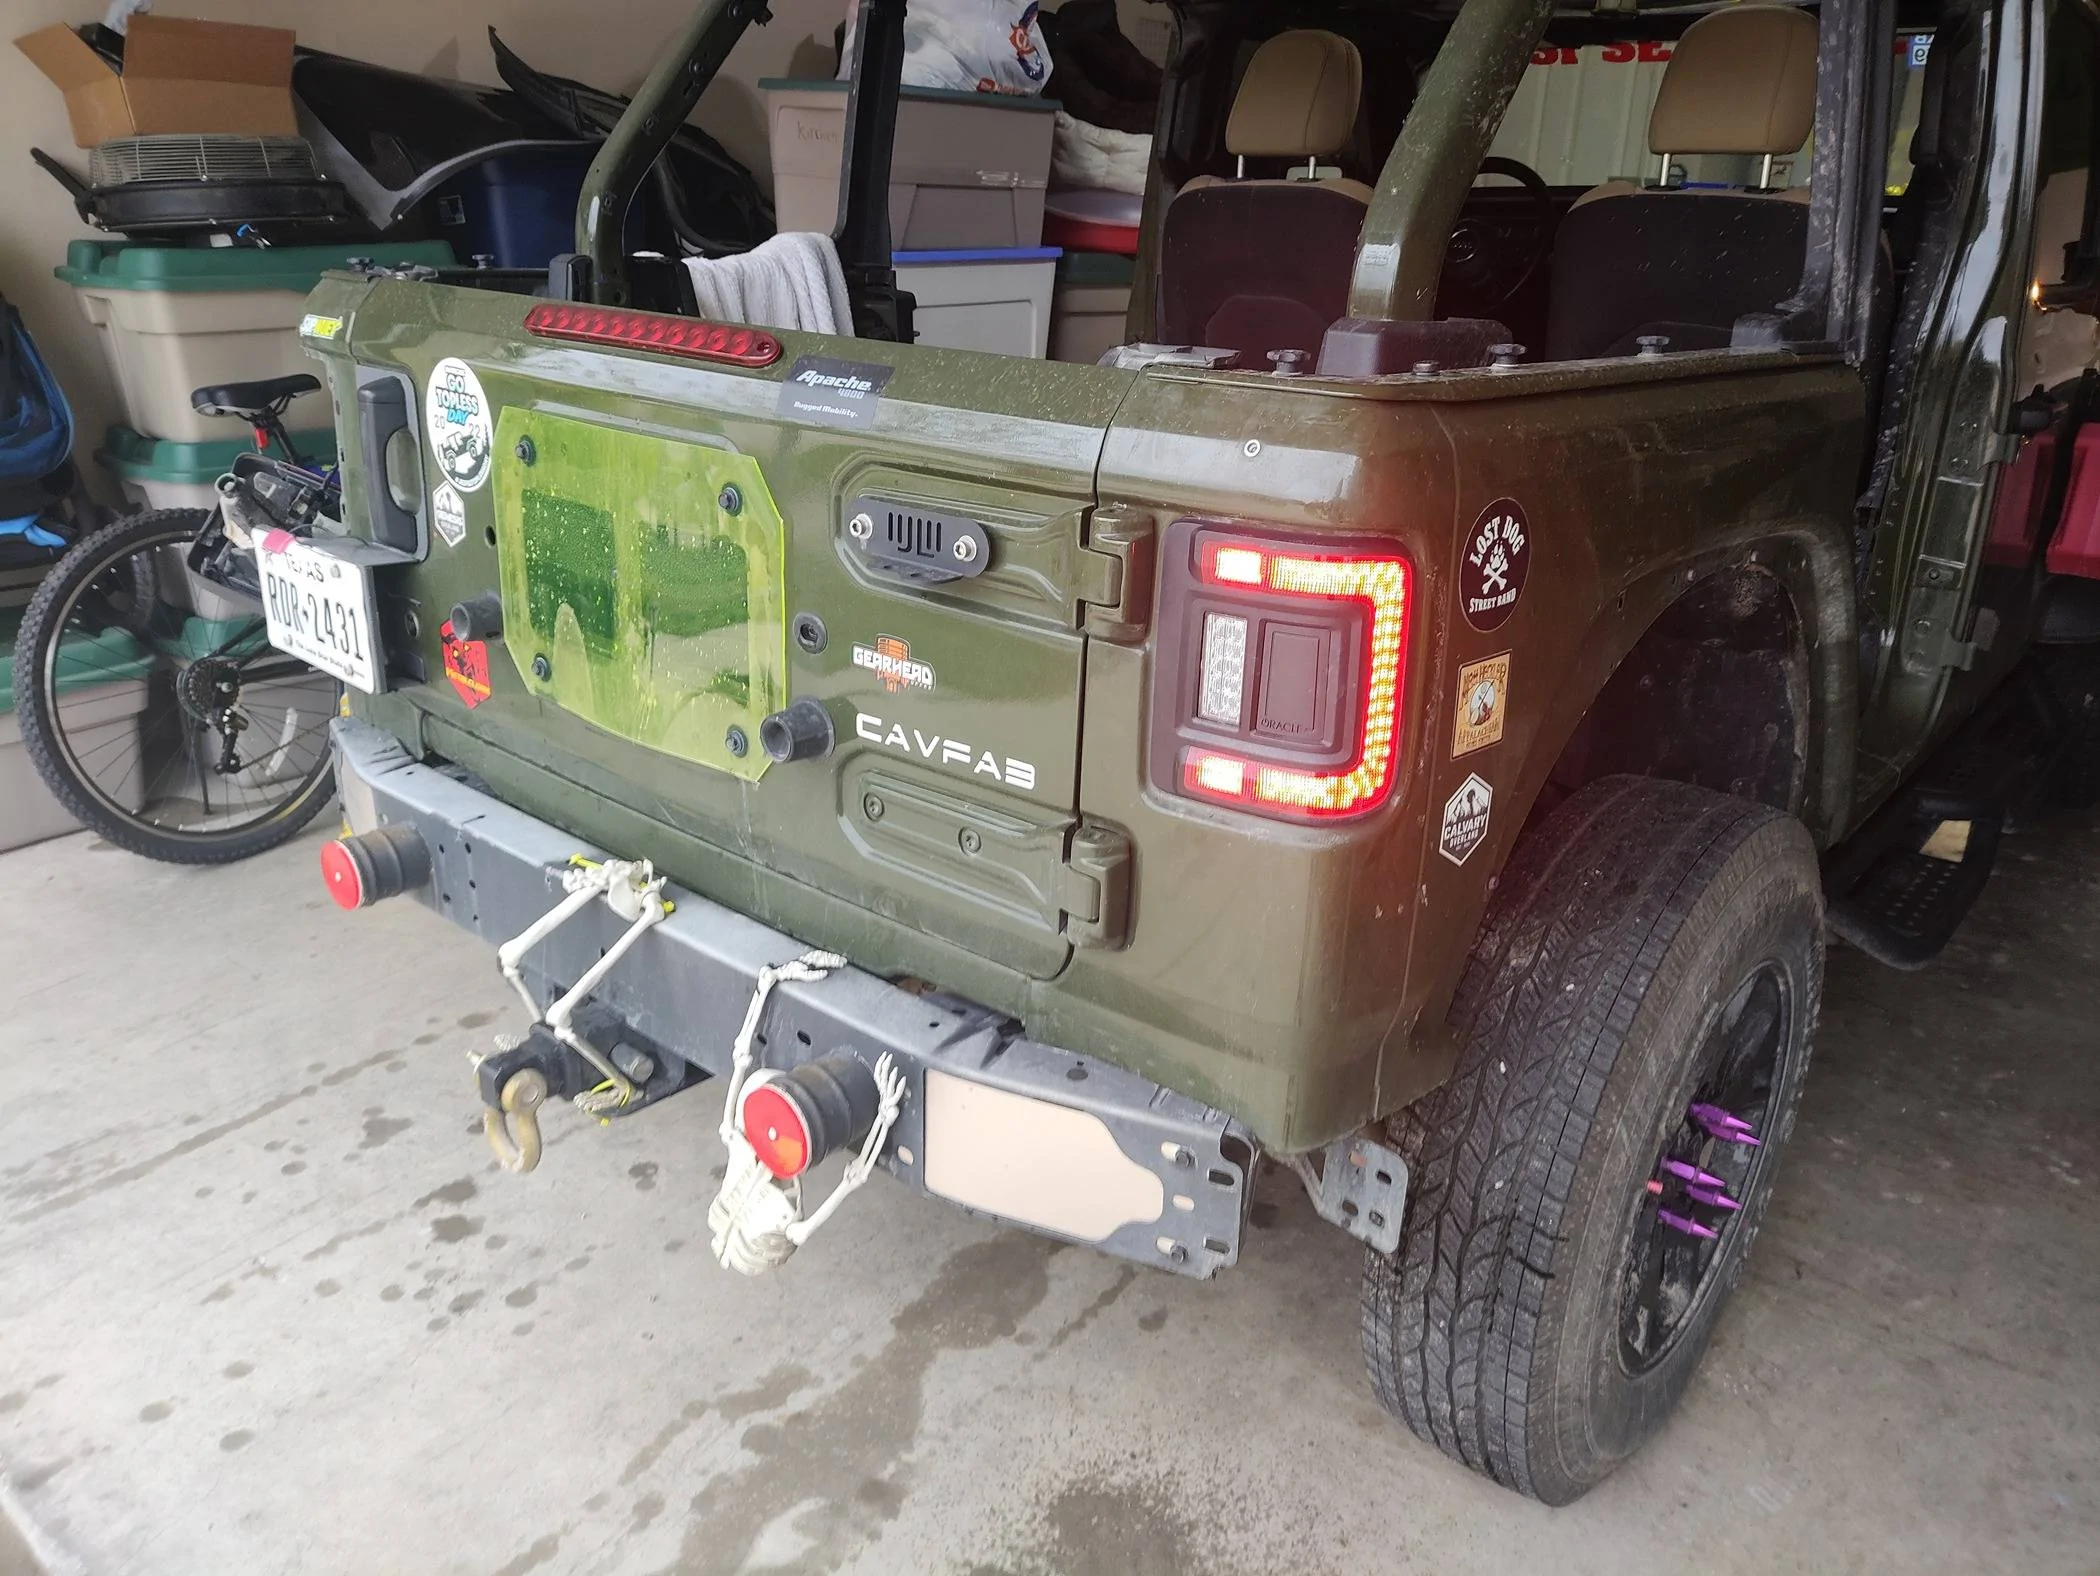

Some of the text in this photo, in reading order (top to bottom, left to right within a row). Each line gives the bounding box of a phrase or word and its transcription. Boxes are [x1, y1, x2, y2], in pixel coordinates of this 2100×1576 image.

[446, 373, 466, 393] GO
[435, 386, 479, 416] TOPLESS
[447, 408, 471, 426] DAY
[1469, 515, 1526, 568] LOST DOG
[1469, 594, 1498, 614] STREET
[852, 645, 934, 686] GEARHEAD
[856, 712, 1036, 791] CAVFAB
[1443, 812, 1488, 841] CALVARY
